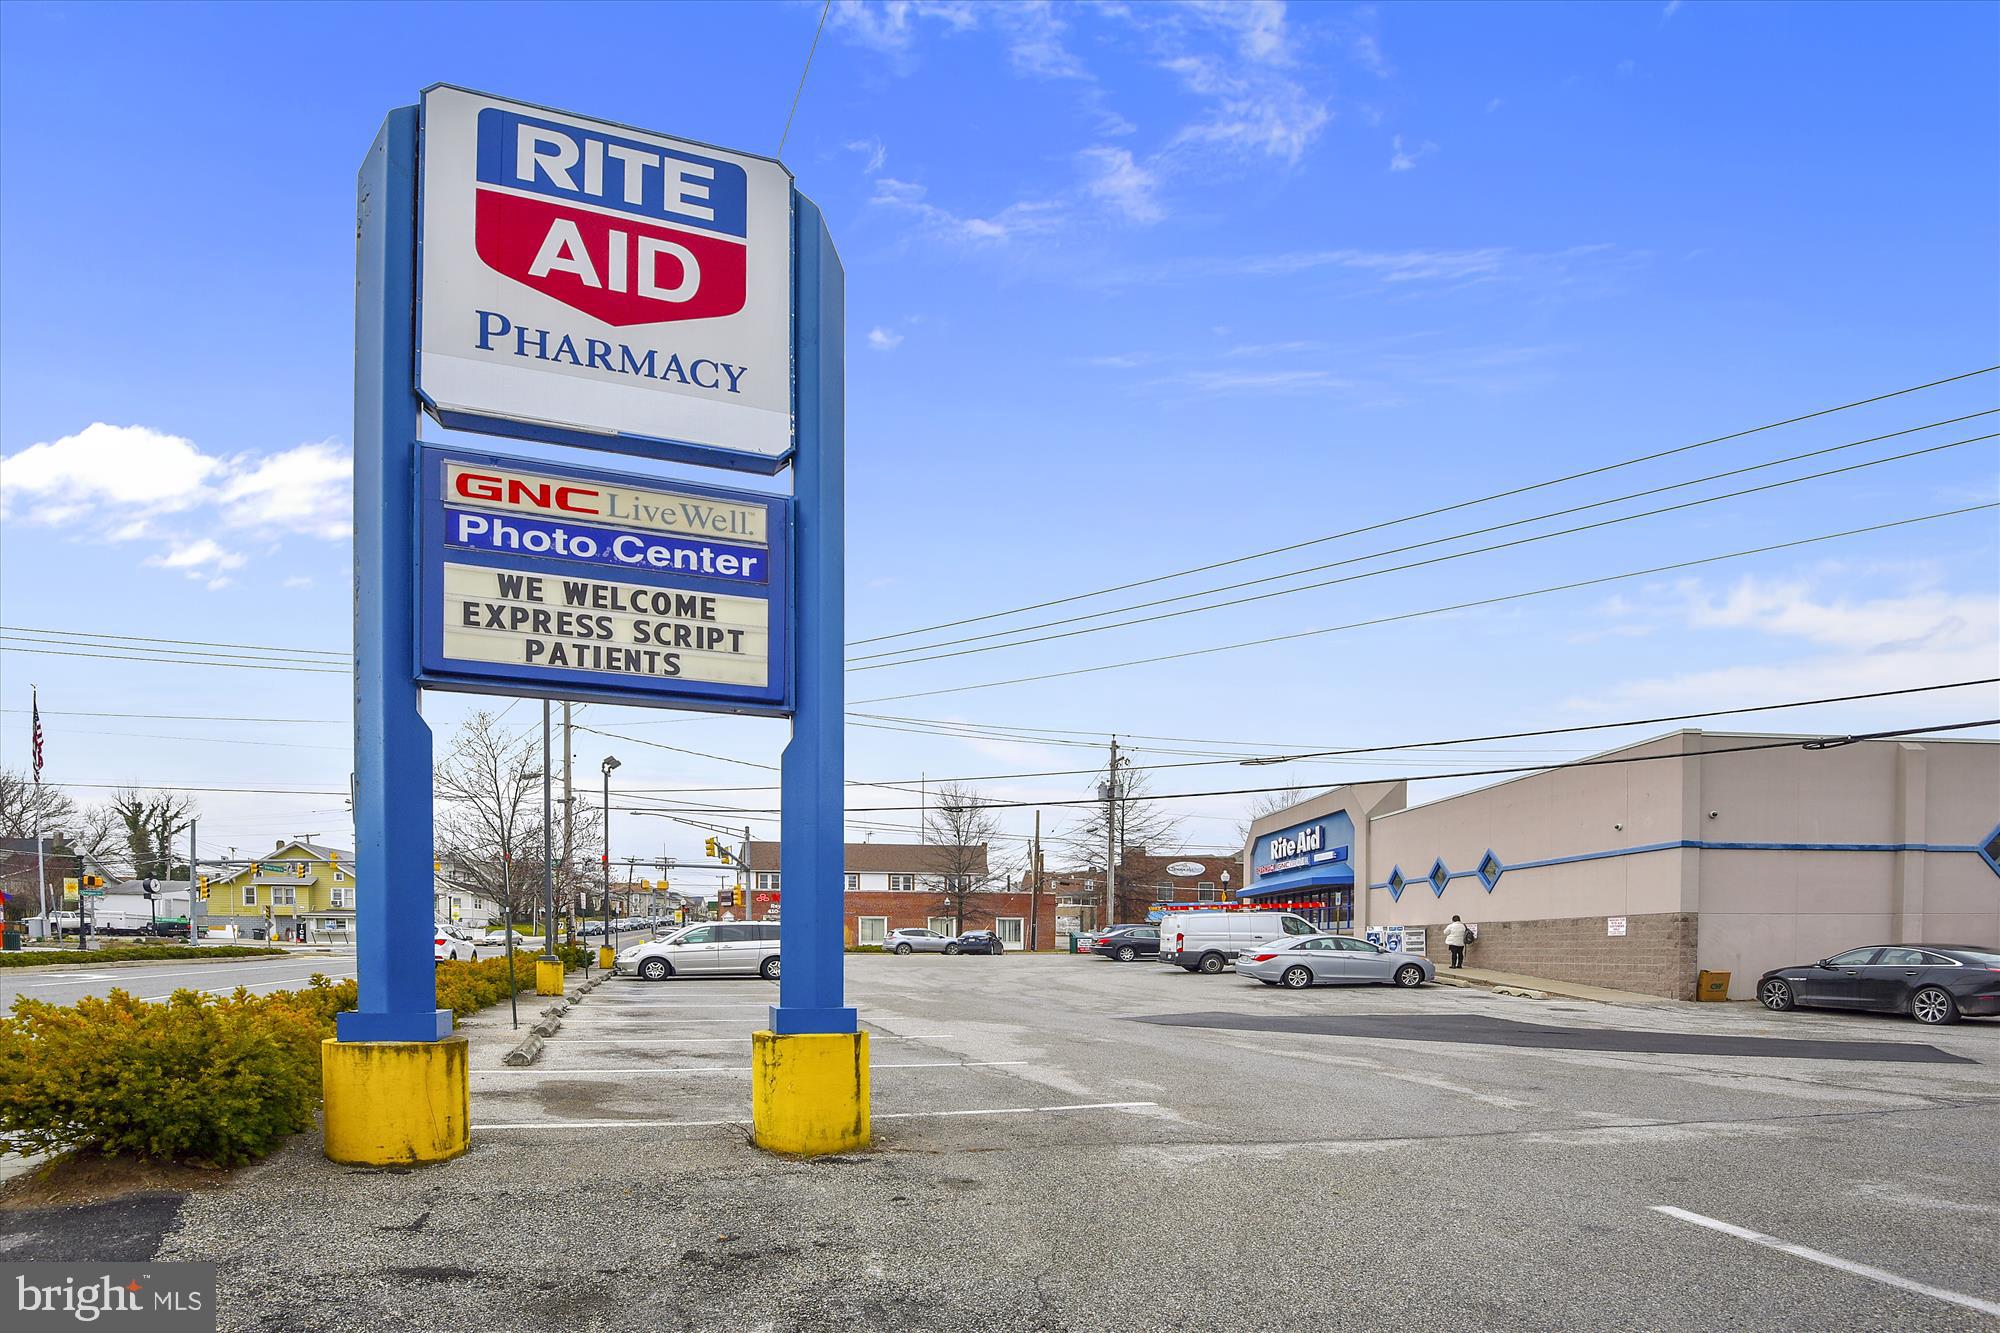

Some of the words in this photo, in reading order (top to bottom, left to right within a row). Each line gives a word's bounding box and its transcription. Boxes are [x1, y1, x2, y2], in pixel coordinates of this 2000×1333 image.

[517, 123, 715, 221] RITE
[528, 217, 700, 303] AID
[475, 310, 748, 394] PHARMACY
[455, 472, 599, 515] GNC
[458, 514, 597, 558] Photo
[612, 534, 758, 577] Center
[497, 573, 544, 602] WE
[563, 580, 717, 621] WELCOME
[463, 601, 614, 640] EXPRESS
[634, 619, 745, 653] SCRIPT
[525, 638, 682, 676] PATIENTS
[1271, 837, 1296, 859] Rite
[1296, 825, 1320, 854] Aid
